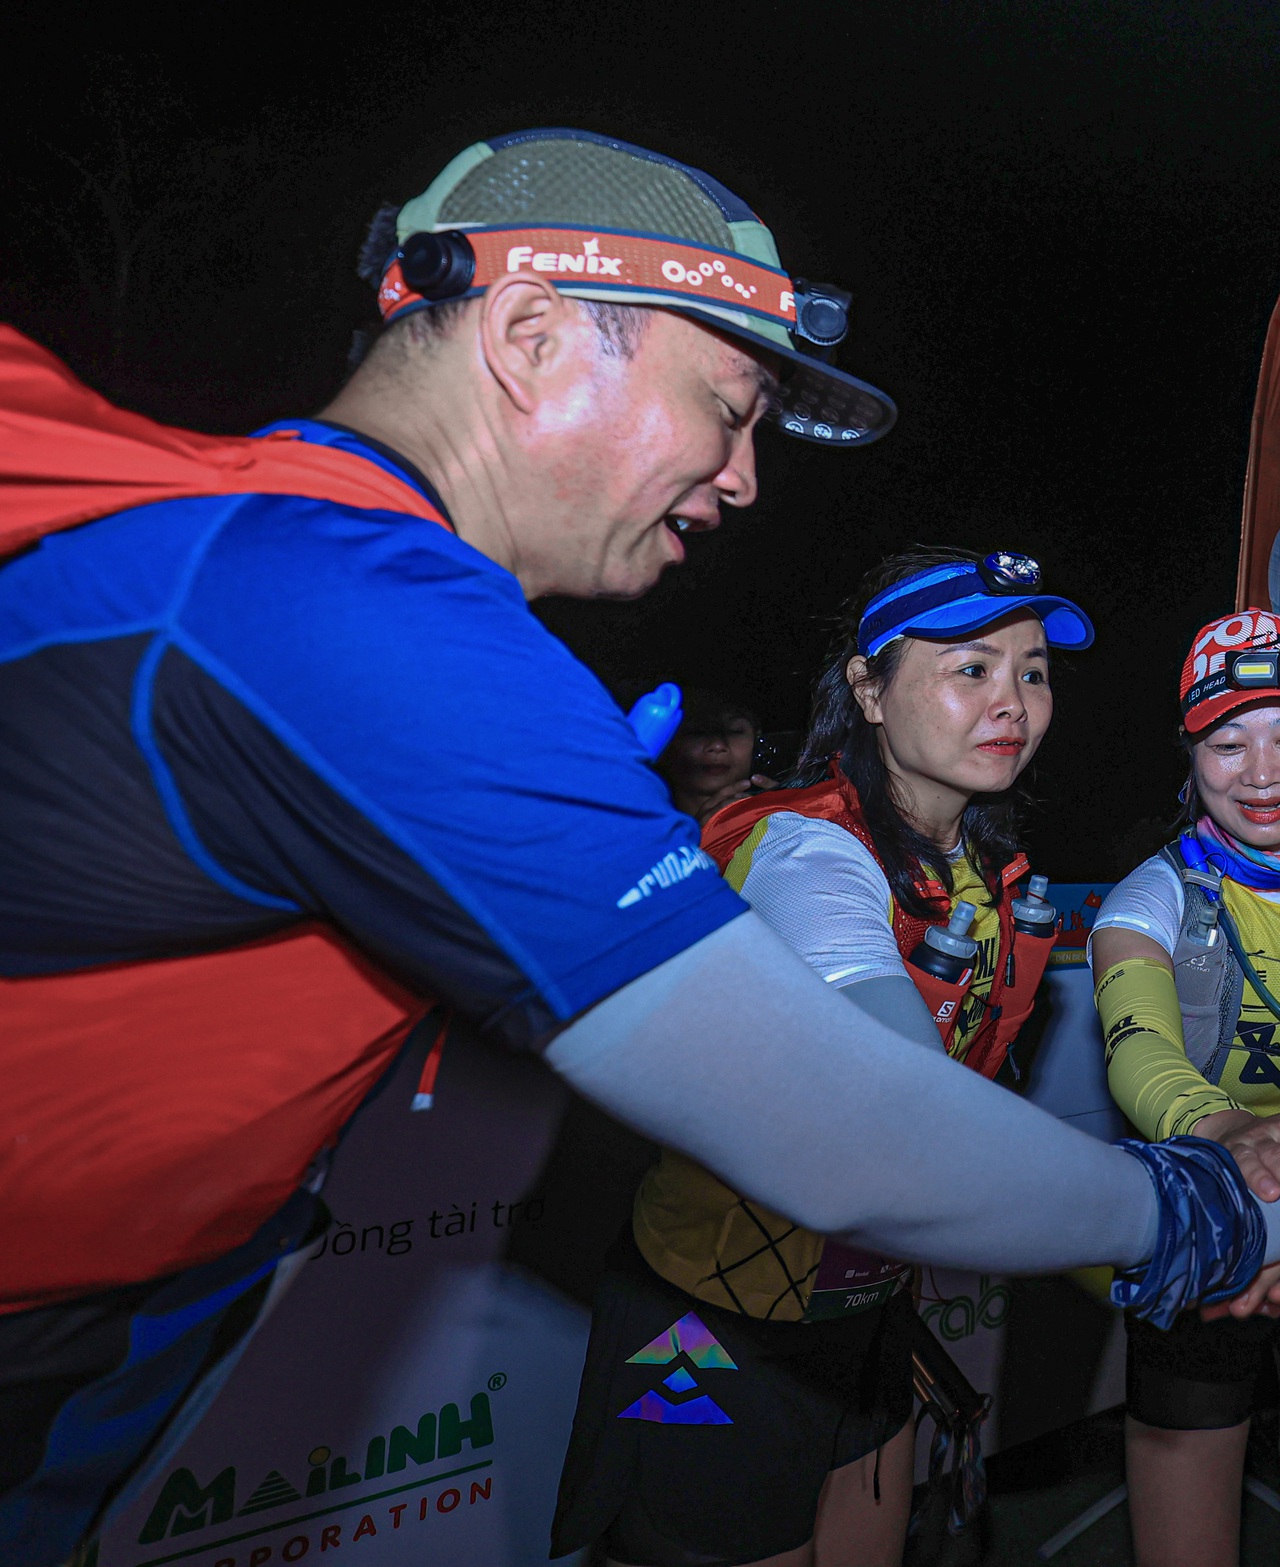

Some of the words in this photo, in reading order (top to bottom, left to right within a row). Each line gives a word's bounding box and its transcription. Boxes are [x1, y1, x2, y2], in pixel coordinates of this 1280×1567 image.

[506, 237, 623, 277] FENIX
[429, 1202, 477, 1238] tài
[844, 1291, 880, 1309] 70km
